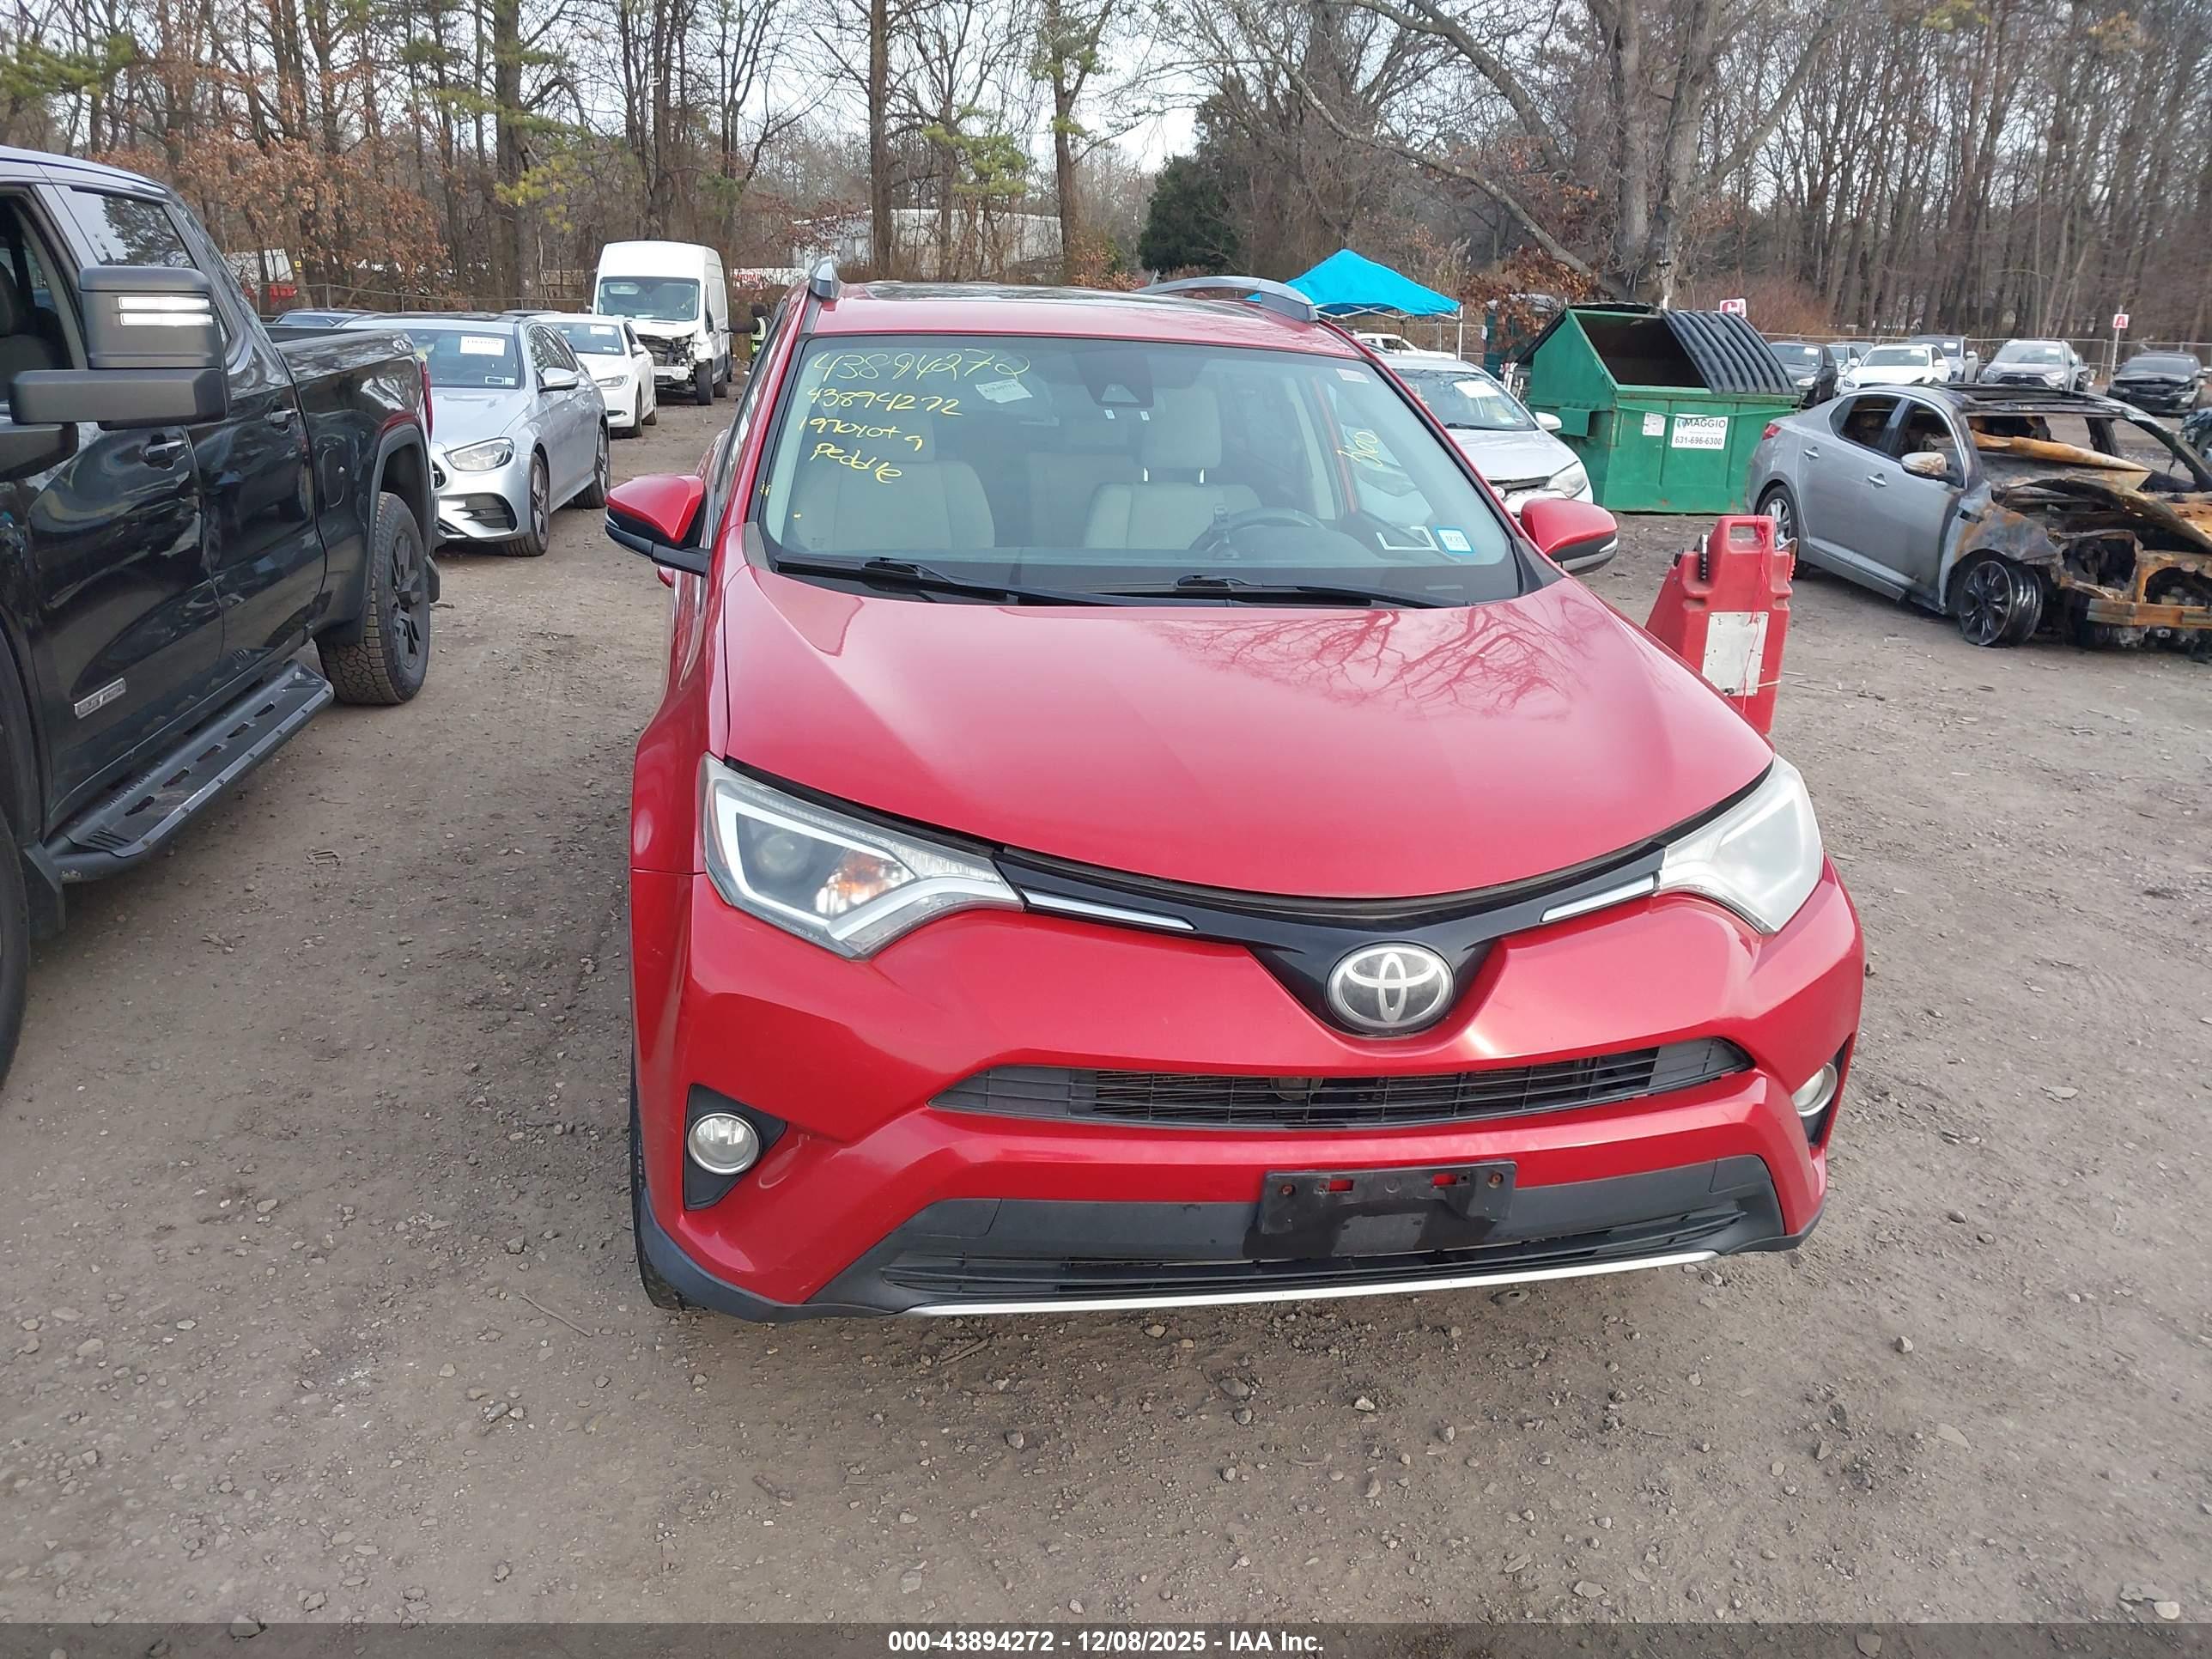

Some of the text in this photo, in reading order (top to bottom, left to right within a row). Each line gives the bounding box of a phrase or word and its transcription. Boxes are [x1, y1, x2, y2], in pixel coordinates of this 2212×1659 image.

[2115, 315, 2126, 327] A
[814, 349, 1030, 381] 43894272
[807, 387, 963, 416] 43894272
[1685, 417, 1727, 428] MAGGIO
[1674, 435, 1723, 446] 631-696-6300
